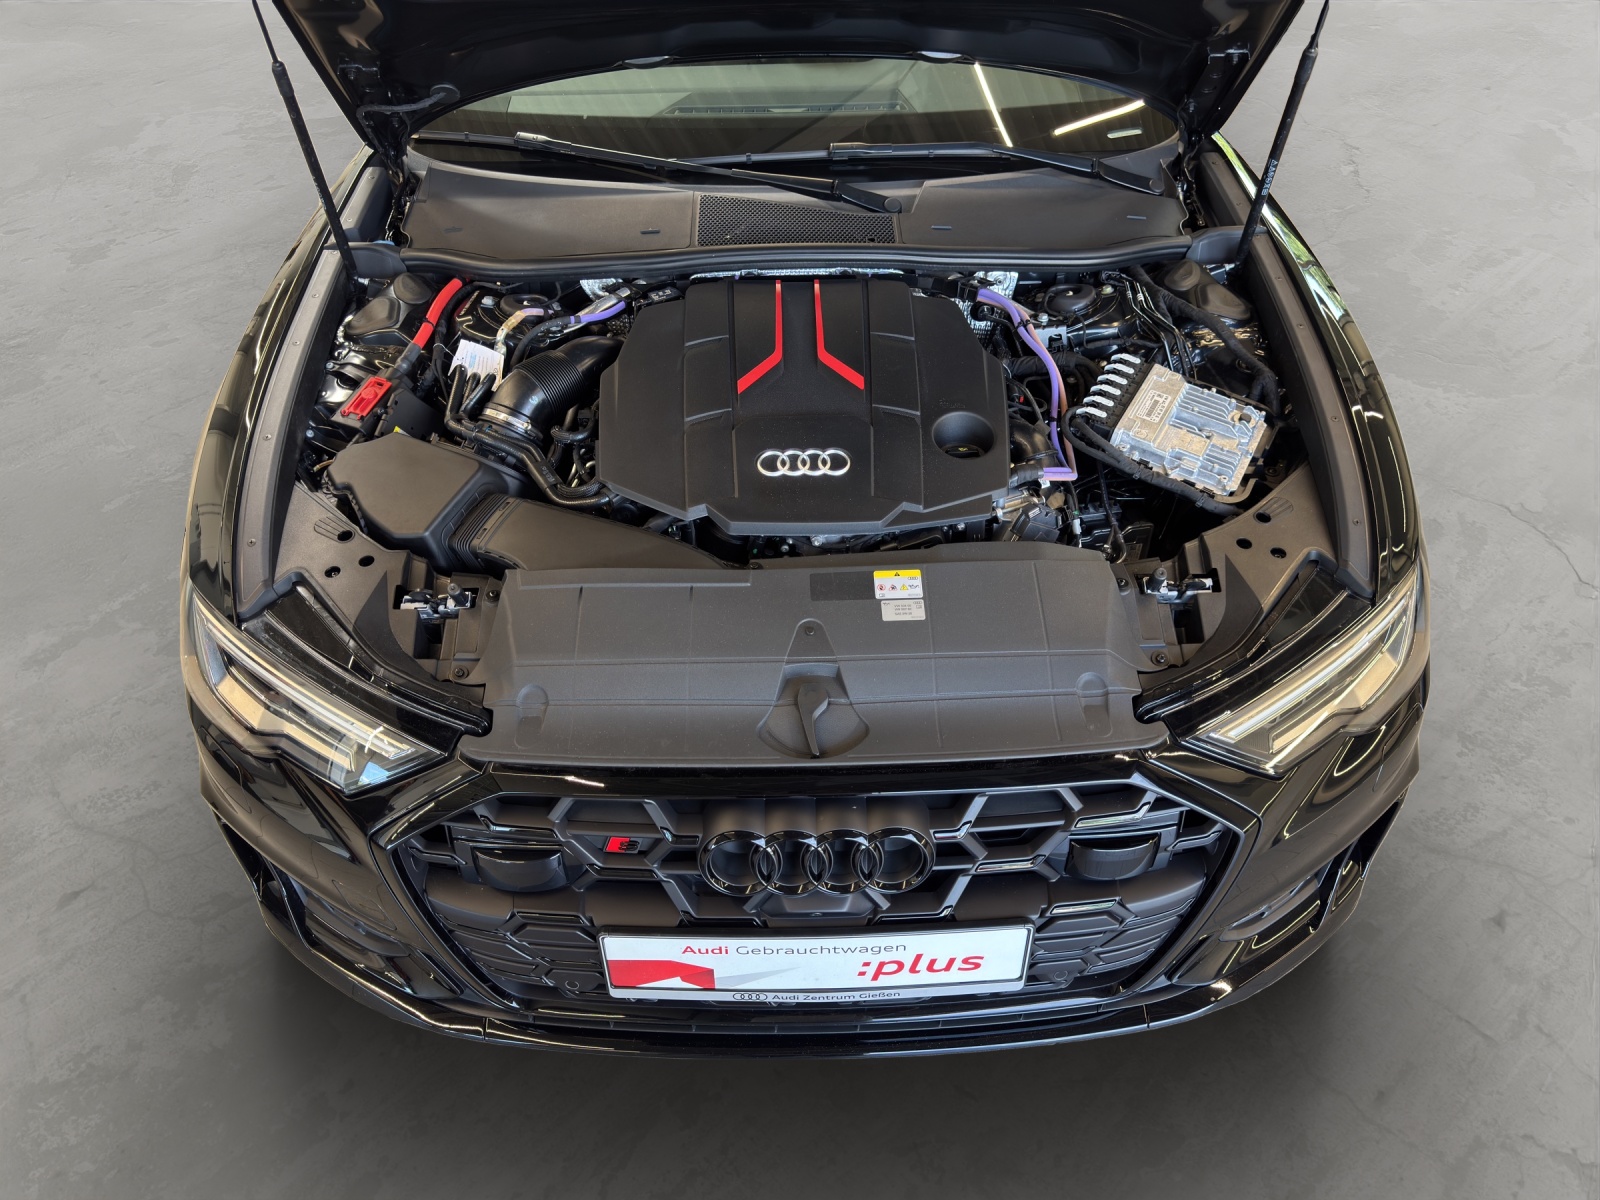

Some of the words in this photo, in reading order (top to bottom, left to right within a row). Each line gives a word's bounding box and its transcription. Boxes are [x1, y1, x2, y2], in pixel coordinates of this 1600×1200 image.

[682, 945, 729, 955] Audi
[735, 944, 907, 956] Gebrauchtwagen
[803, 993, 856, 1001] Zentrum
[859, 991, 901, 999] Gießen
